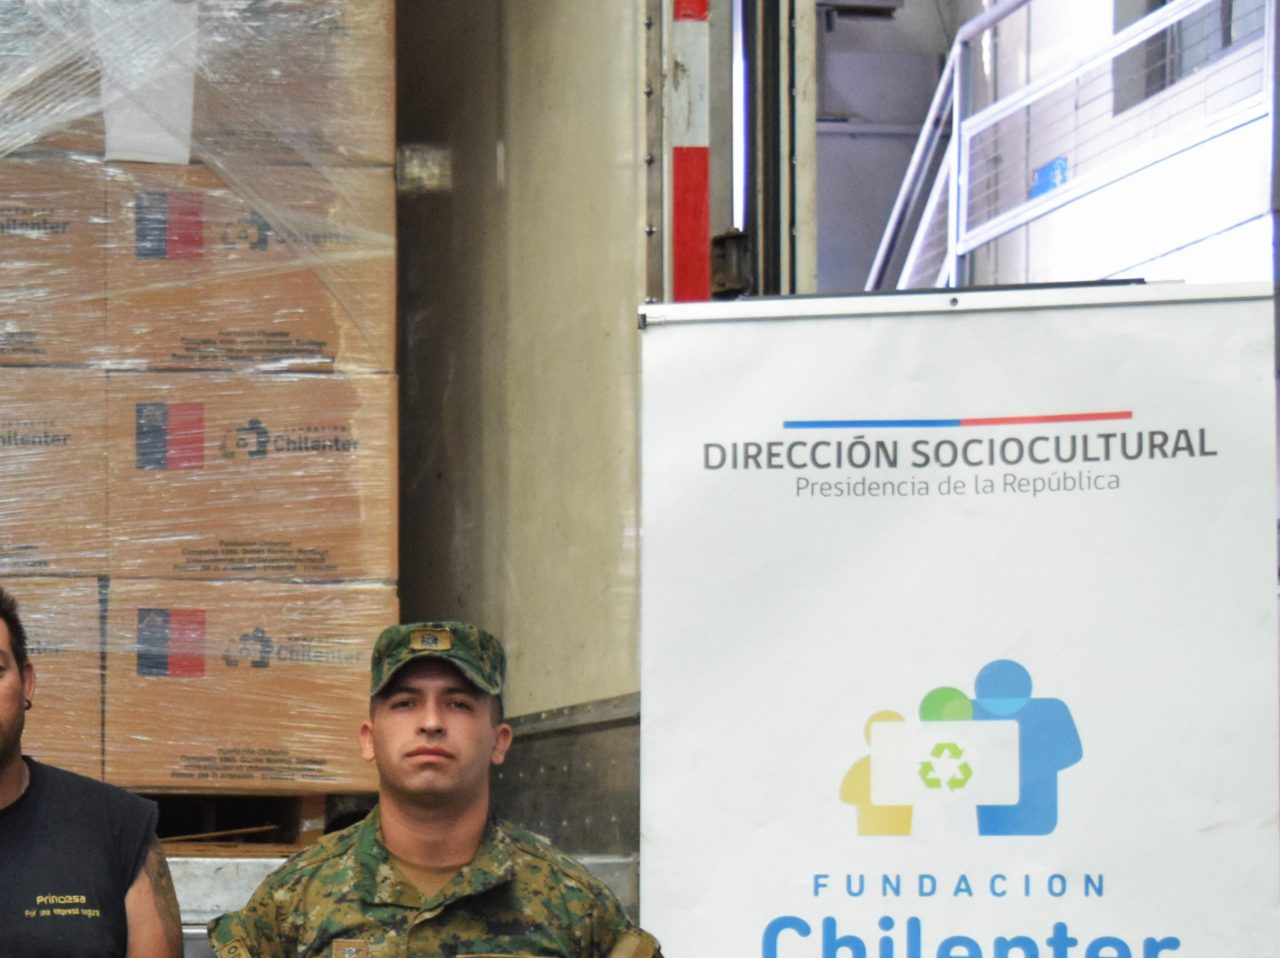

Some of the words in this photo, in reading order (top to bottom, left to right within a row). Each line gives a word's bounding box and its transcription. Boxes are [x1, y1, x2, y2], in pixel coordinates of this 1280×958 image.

[274, 432, 359, 452] Chilenter
[703, 435, 898, 470] DIRECCIÓN
[911, 428, 1218, 468] SOCIOCULTURAL
[795, 475, 930, 498] Presidencia
[937, 475, 965, 496] de
[974, 474, 995, 495] la
[1003, 470, 1121, 498] República
[812, 873, 1106, 898] FUNDACION
